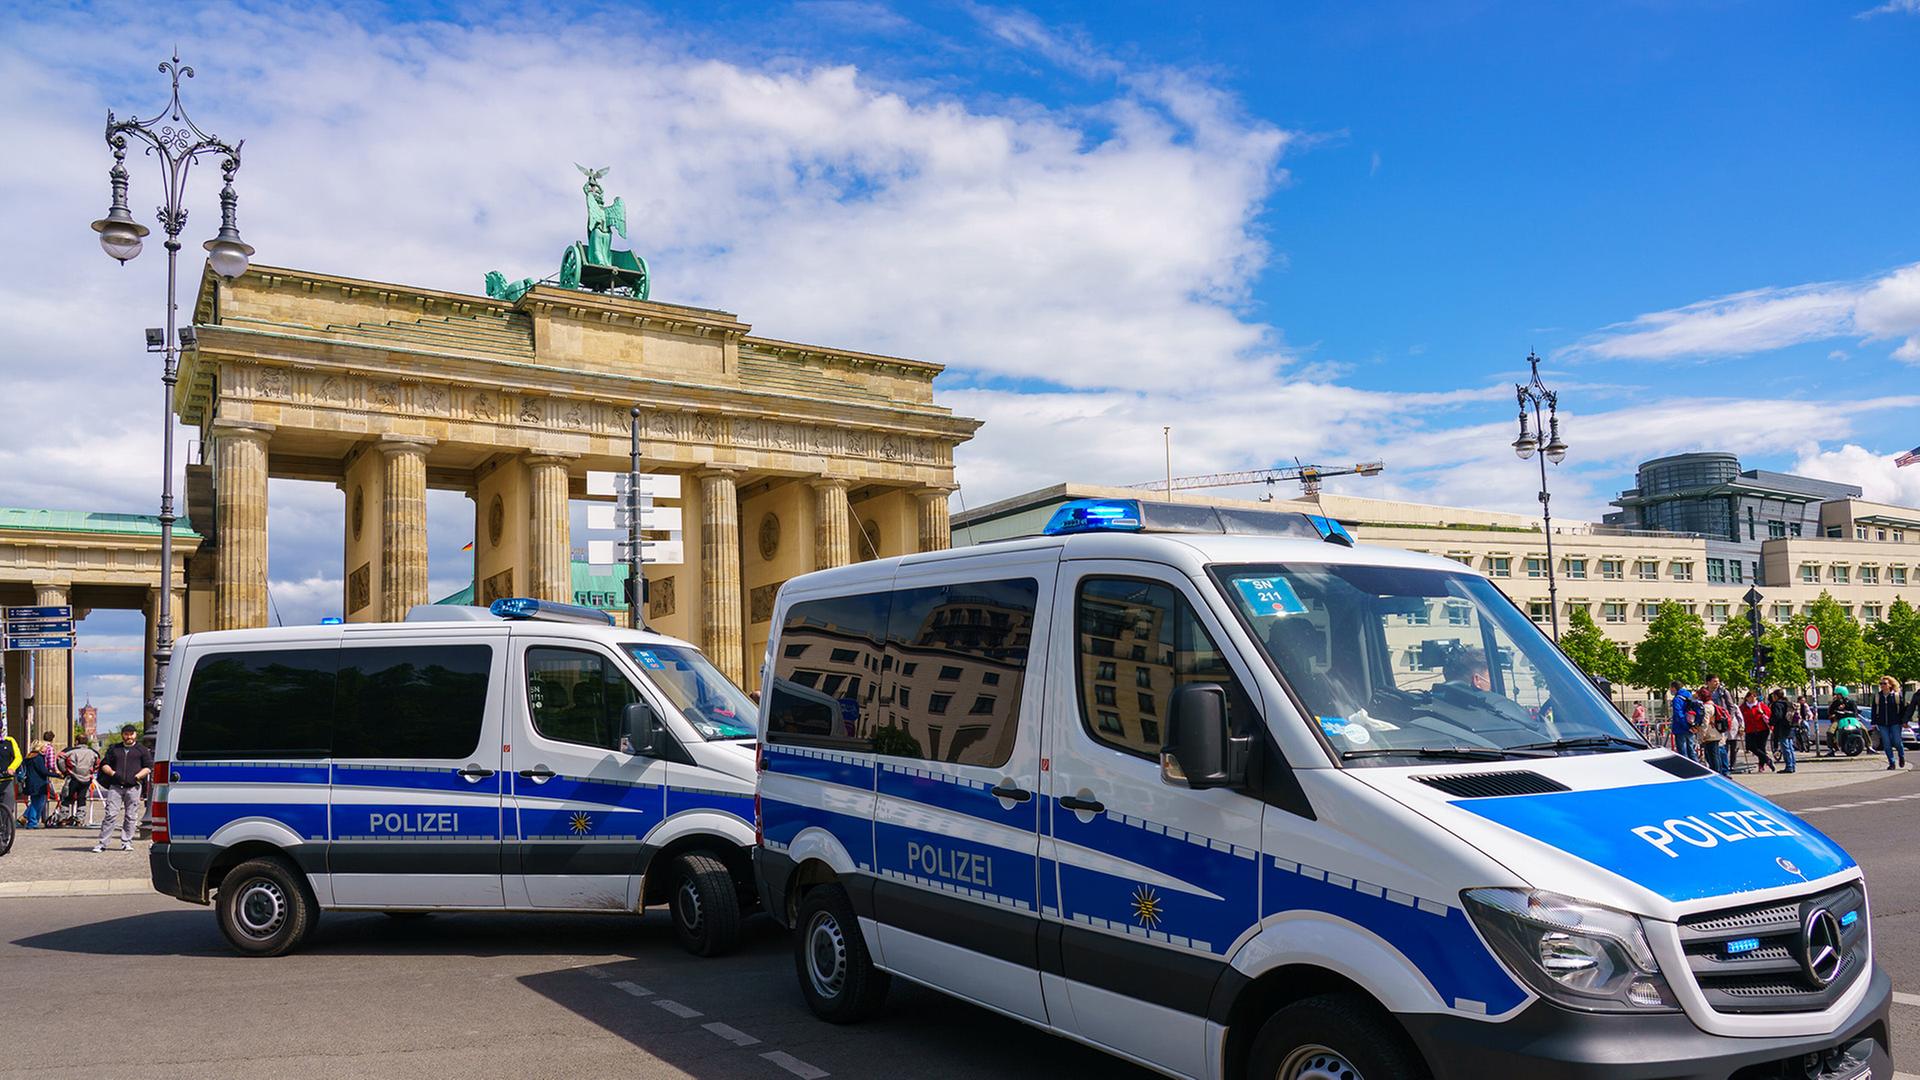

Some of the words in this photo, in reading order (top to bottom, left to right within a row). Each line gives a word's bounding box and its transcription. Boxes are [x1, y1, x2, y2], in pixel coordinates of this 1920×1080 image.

[1252, 580, 1273, 589] SN
[1257, 591, 1282, 602] 211
[369, 812, 459, 833] POLIZEI
[1630, 810, 1802, 858] POLIZEI
[907, 841, 993, 888] POLIZEI
